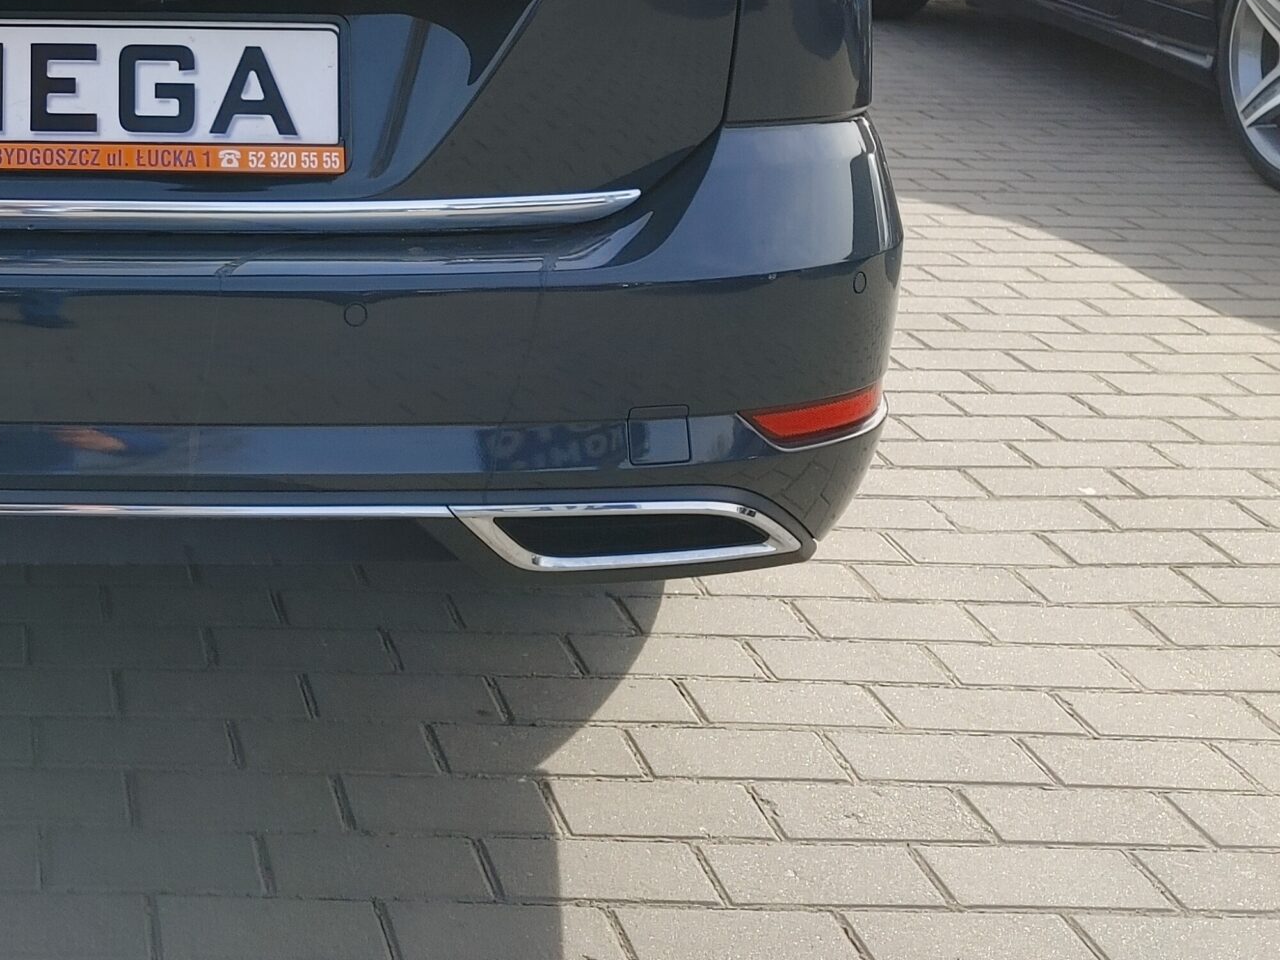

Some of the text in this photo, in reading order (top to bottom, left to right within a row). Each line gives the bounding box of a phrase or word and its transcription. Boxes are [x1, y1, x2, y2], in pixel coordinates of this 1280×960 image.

[106, 149, 129, 167] ul.
[136, 148, 196, 168] ŁUCKA
[202, 150, 211, 168] 1
[248, 151, 266, 169] 52
[270, 151, 297, 169] 320
[301, 151, 318, 169] 55
[322, 152, 340, 170] 55
